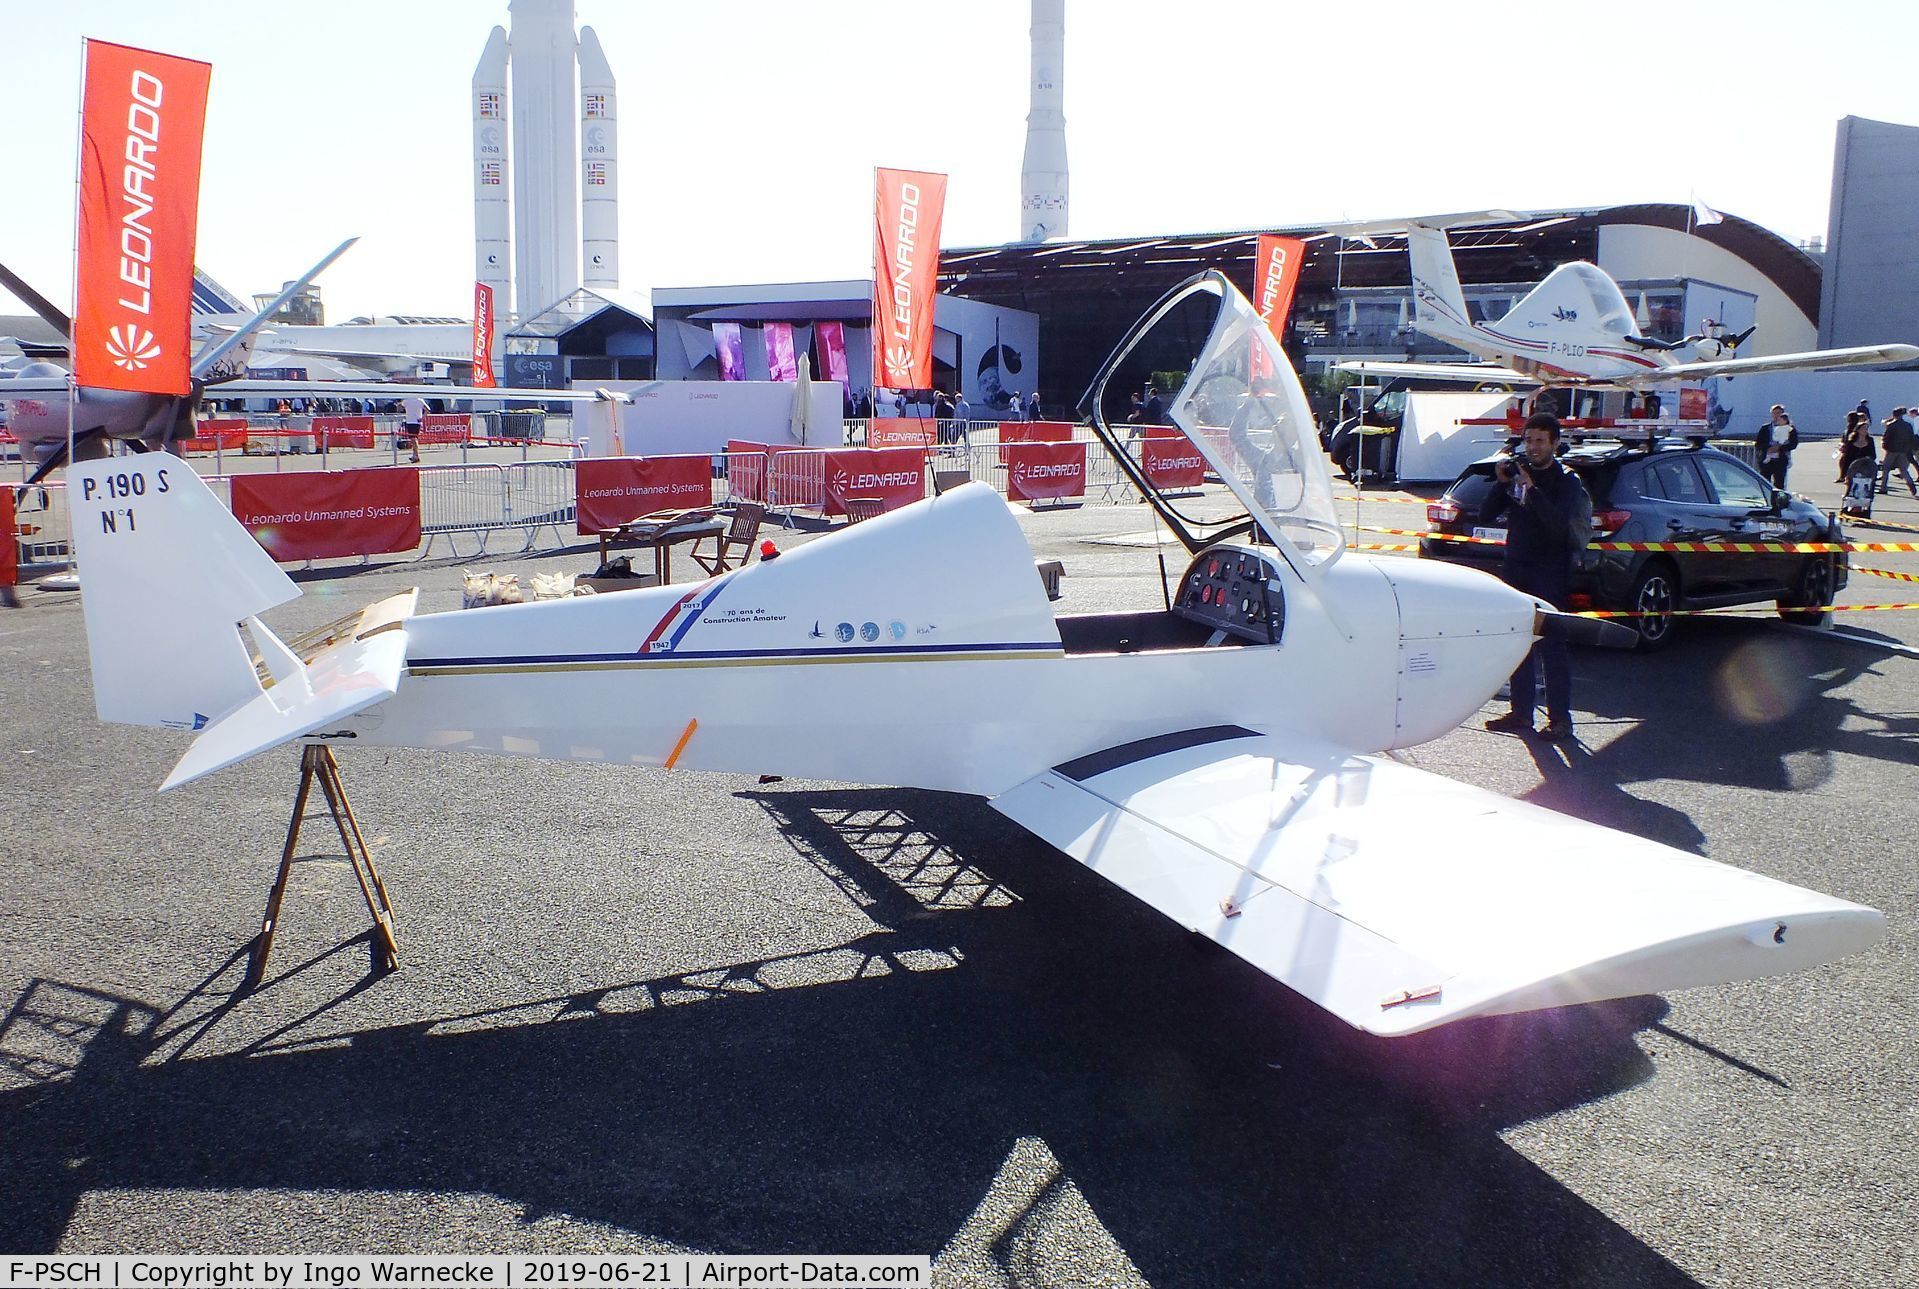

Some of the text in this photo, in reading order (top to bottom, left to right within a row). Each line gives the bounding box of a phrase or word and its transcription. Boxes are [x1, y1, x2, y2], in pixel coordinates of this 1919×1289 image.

[481, 145, 500, 154] esa
[587, 145, 605, 153] esa
[118, 69, 164, 315] LEONARDO
[893, 182, 920, 341] LEONARDO
[474, 290, 487, 365] LEONARDO
[1550, 342, 1584, 357] F-PLIO
[529, 361, 552, 371] esa
[426, 424, 468, 433] LEONARDO
[881, 432, 931, 442] LEONARDO
[1027, 463, 1081, 478] LEONARDO
[1157, 456, 1201, 470] LEONARDO
[157, 469, 170, 493] S
[849, 471, 919, 489] LEONARDO
[584, 483, 704, 498] Leonardo Unmanned Systems
[244, 504, 411, 525] Leonardo Unmanned Systems
[703, 616, 751, 624] Construction
